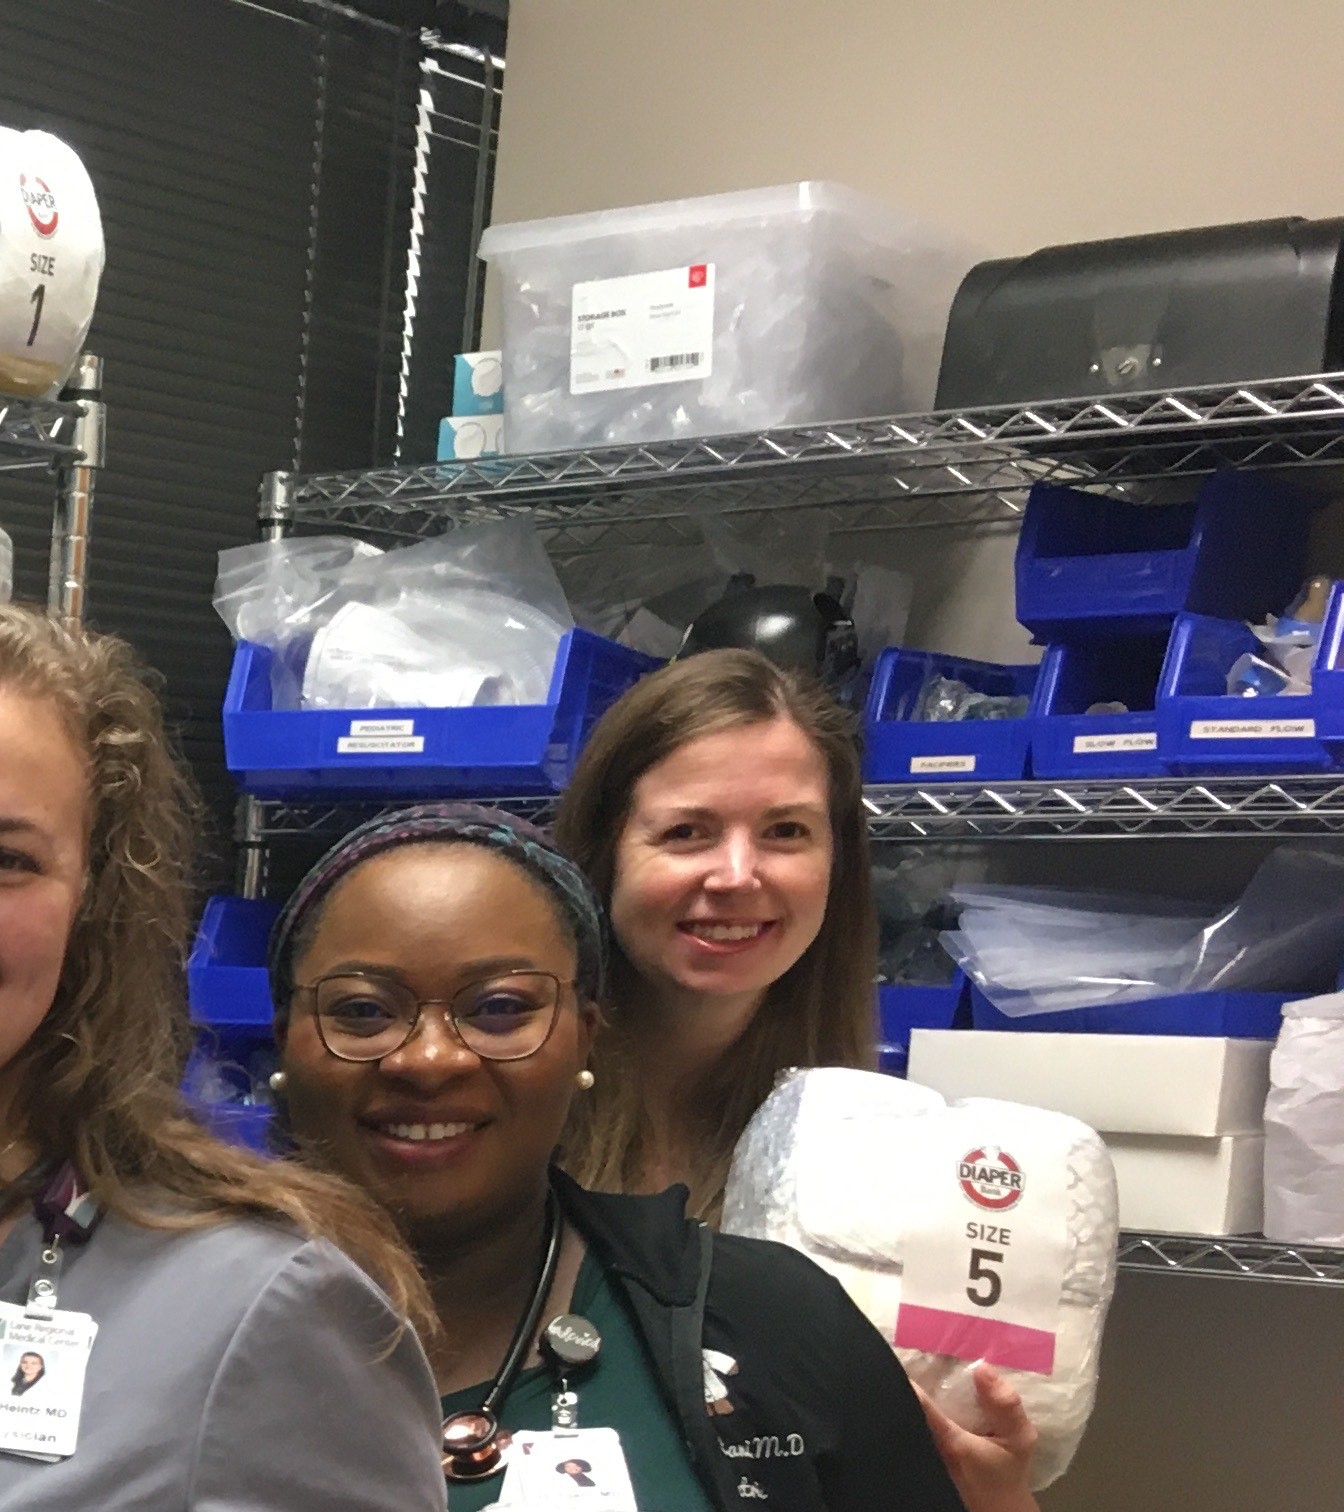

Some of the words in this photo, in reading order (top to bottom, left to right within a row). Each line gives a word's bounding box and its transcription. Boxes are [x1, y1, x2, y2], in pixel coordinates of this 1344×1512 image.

[29, 251, 56, 277] SIZE
[28, 282, 46, 347] 1
[1202, 725, 1262, 734] STANDARD
[959, 1163, 1022, 1189] DIAPER
[965, 1221, 1012, 1246] SIZE
[965, 1247, 1004, 1307] 5
[45, 1407, 68, 1418] MD
